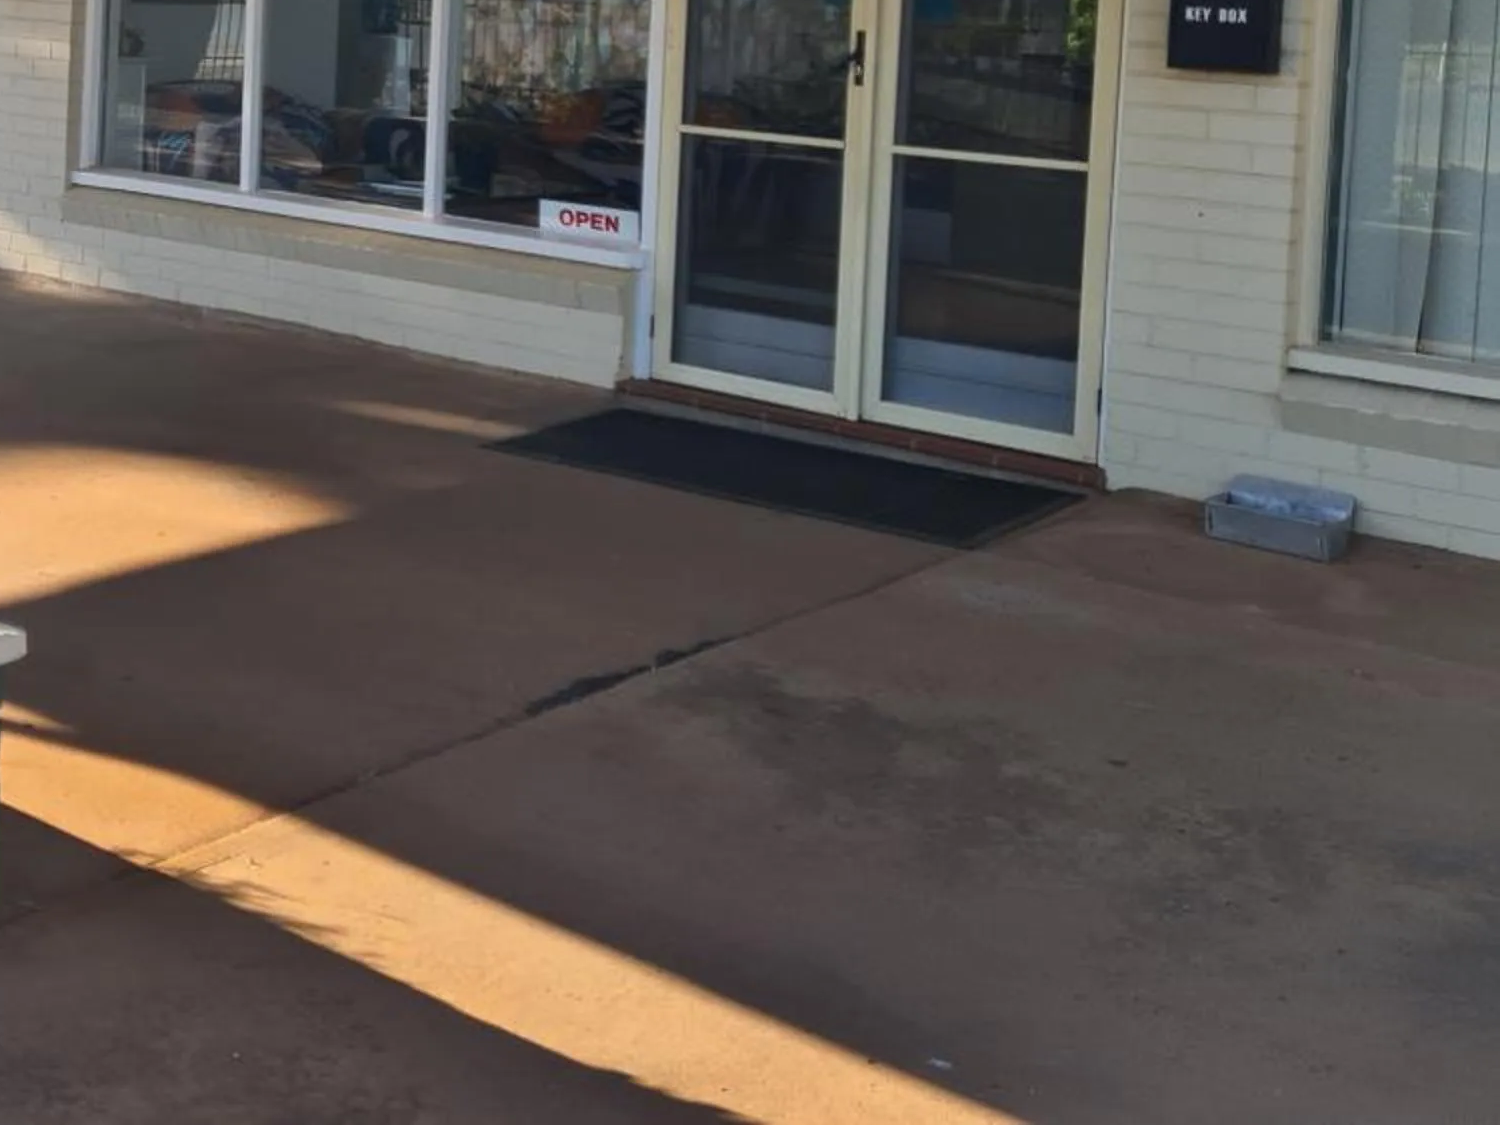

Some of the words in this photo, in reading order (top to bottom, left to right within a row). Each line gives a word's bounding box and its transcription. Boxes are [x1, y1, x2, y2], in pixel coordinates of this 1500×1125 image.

[1185, 6, 1211, 23] KEY
[1218, 8, 1247, 24] BOX
[559, 208, 619, 233] OPEN
